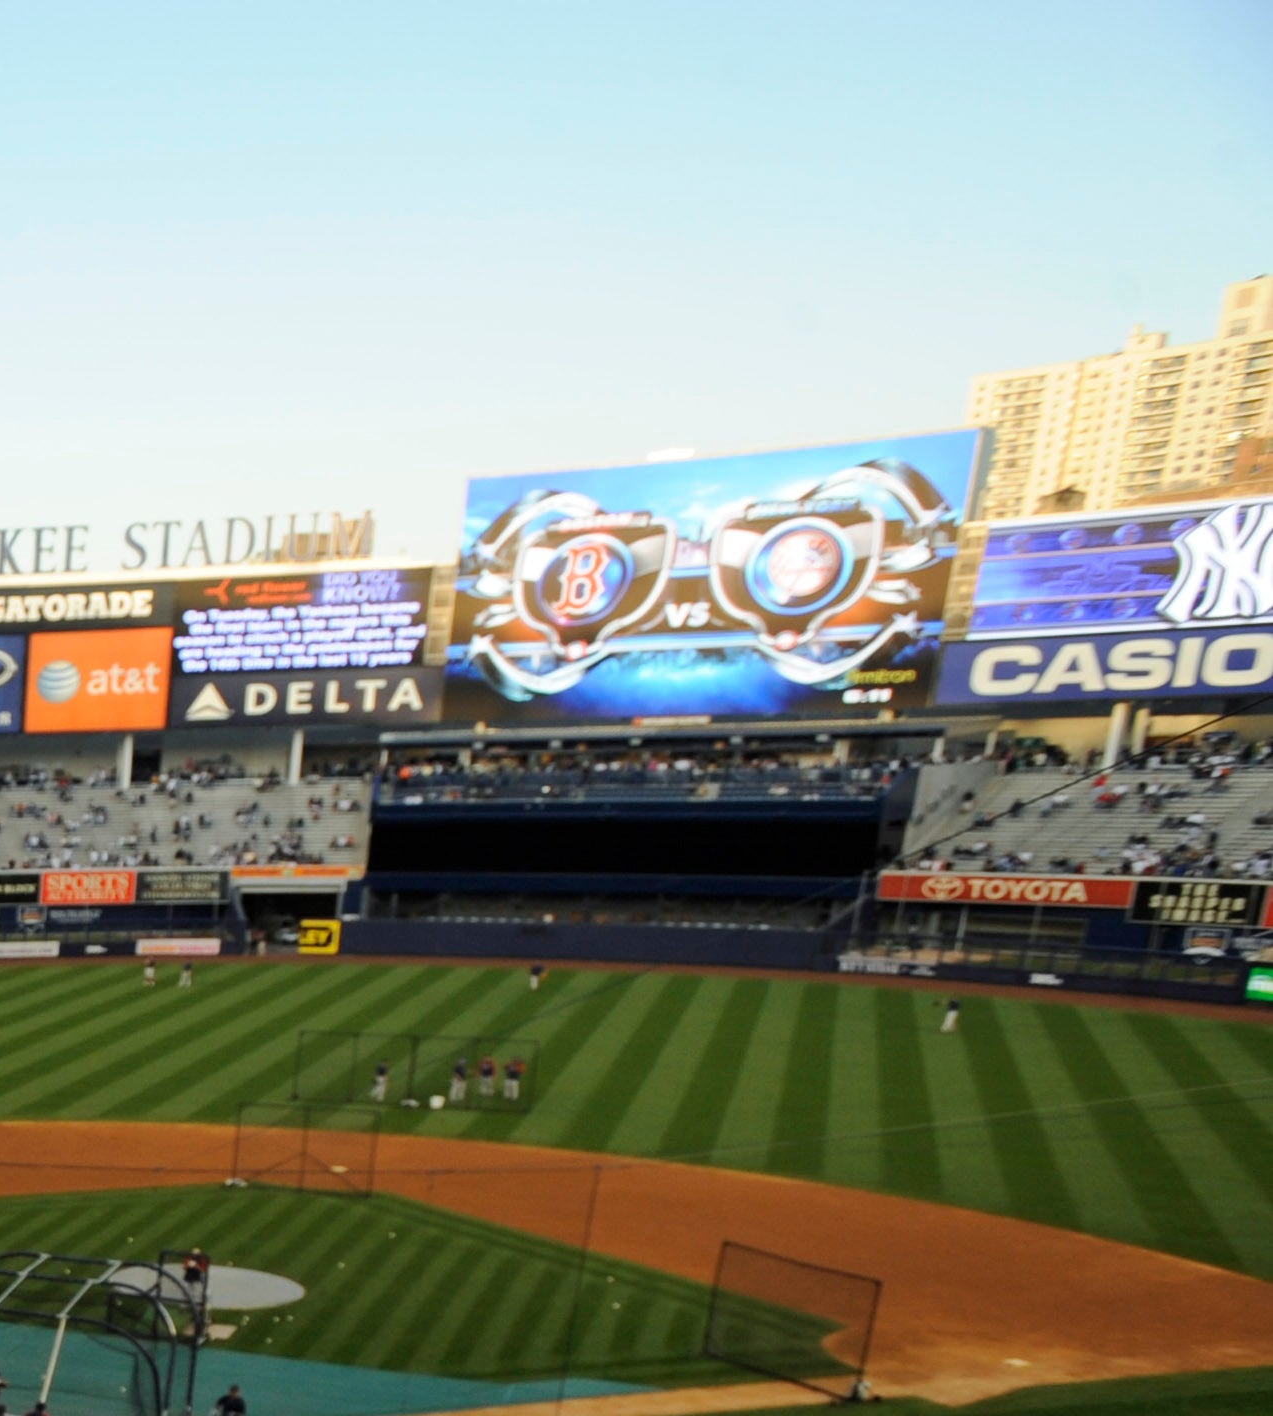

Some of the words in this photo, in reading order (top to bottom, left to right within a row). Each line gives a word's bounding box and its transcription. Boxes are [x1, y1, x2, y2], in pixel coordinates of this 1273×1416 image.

[122, 510, 374, 571] STADIUM
[325, 571, 356, 586] DID
[360, 570, 398, 584] YOU
[322, 582, 401, 604] KNOW?
[662, 603, 711, 628] VS
[968, 632, 1273, 697] CASIO
[86, 662, 161, 695] at&t
[243, 678, 423, 717] DELTA
[46, 873, 131, 892] SPORTS
[967, 878, 1088, 903] TOYOTA
